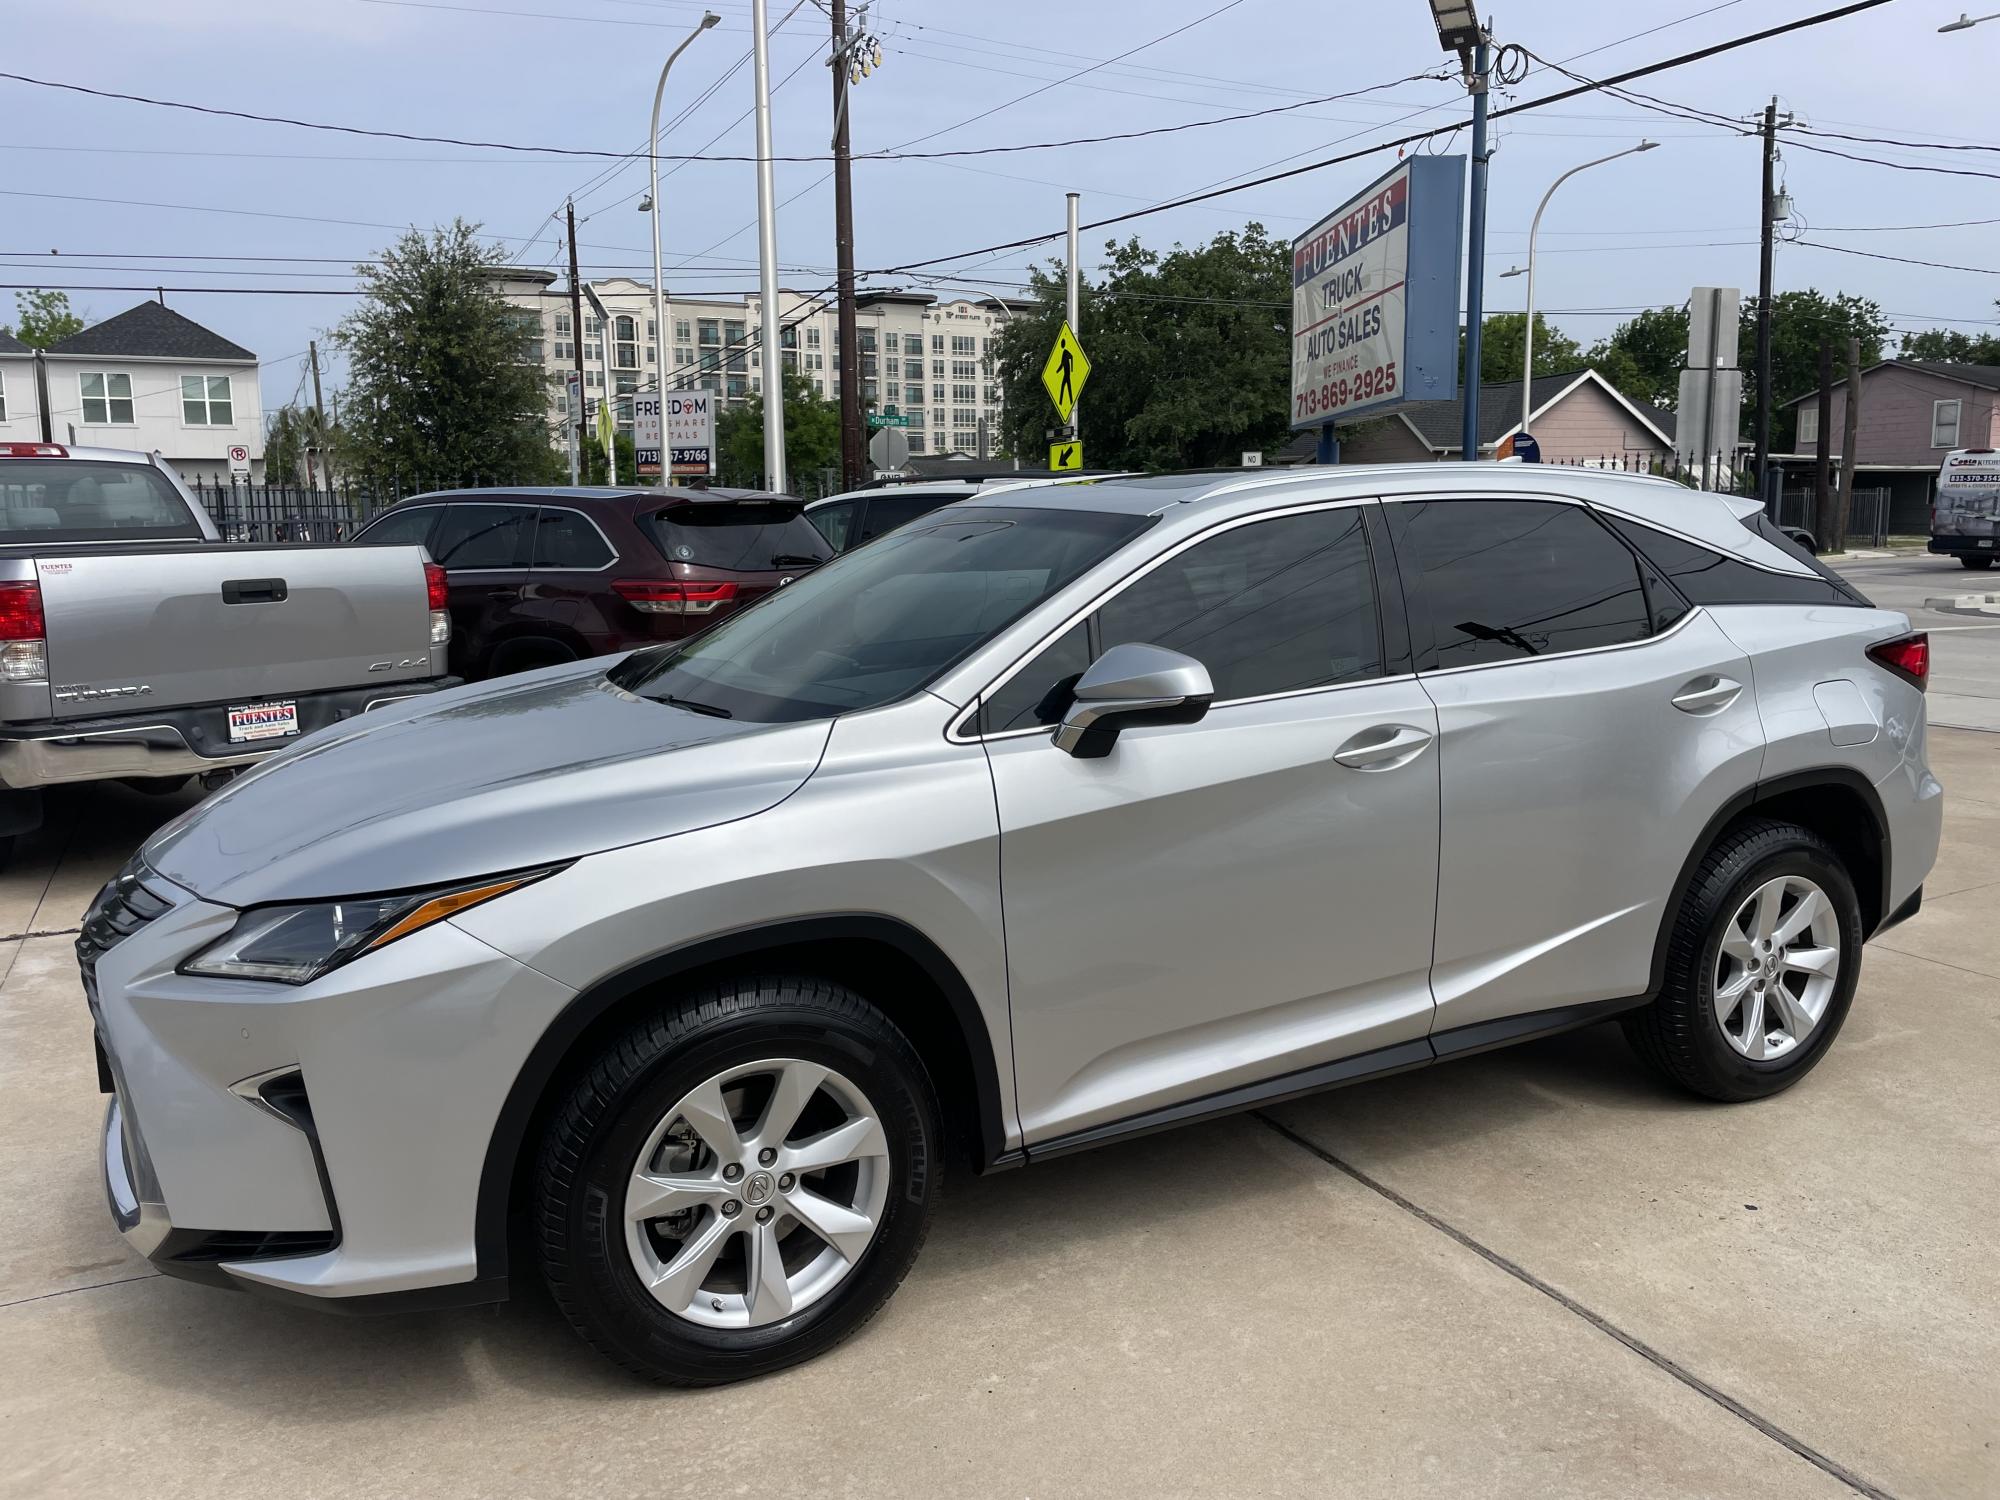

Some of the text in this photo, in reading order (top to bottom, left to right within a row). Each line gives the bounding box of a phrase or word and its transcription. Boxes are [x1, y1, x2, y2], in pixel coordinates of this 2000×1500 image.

[1302, 189, 1393, 281] FUENTES
[1322, 262, 1364, 310] TRUCK
[1306, 304, 1380, 362] AUTO SALES
[1323, 354, 1358, 379] WE FINANCE
[1296, 362, 1396, 418] 713-869-2925
[875, 416, 900, 425] Durham
[646, 432, 698, 440] RETALS
[1247, 455, 1257, 463] NO
[235, 708, 291, 726] FUENTES
